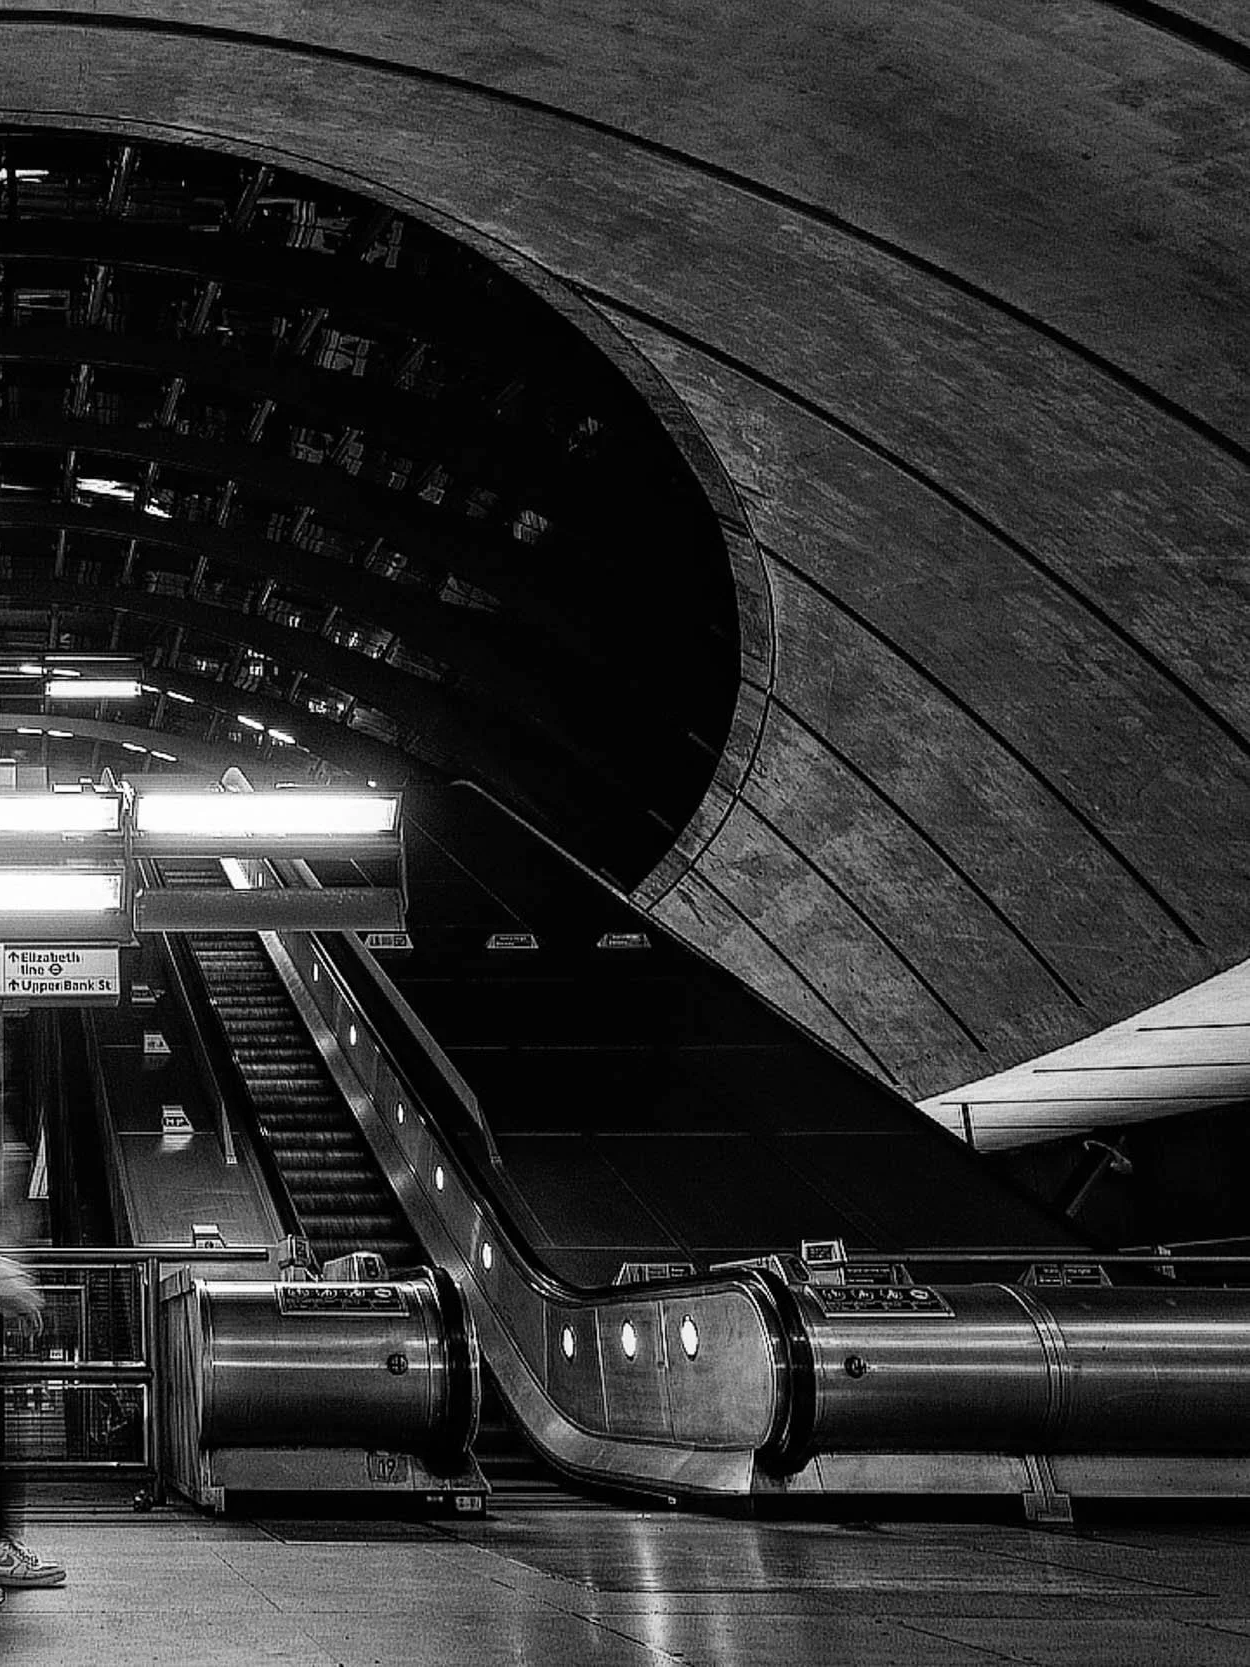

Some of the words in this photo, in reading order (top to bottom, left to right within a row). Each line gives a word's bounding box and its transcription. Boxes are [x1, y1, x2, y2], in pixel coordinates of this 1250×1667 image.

[21, 952, 81, 962] Elizabeth
[21, 964, 45, 975] line
[21, 980, 62, 993] Upper
[63, 980, 95, 991] Bank
[98, 980, 112, 991] St
